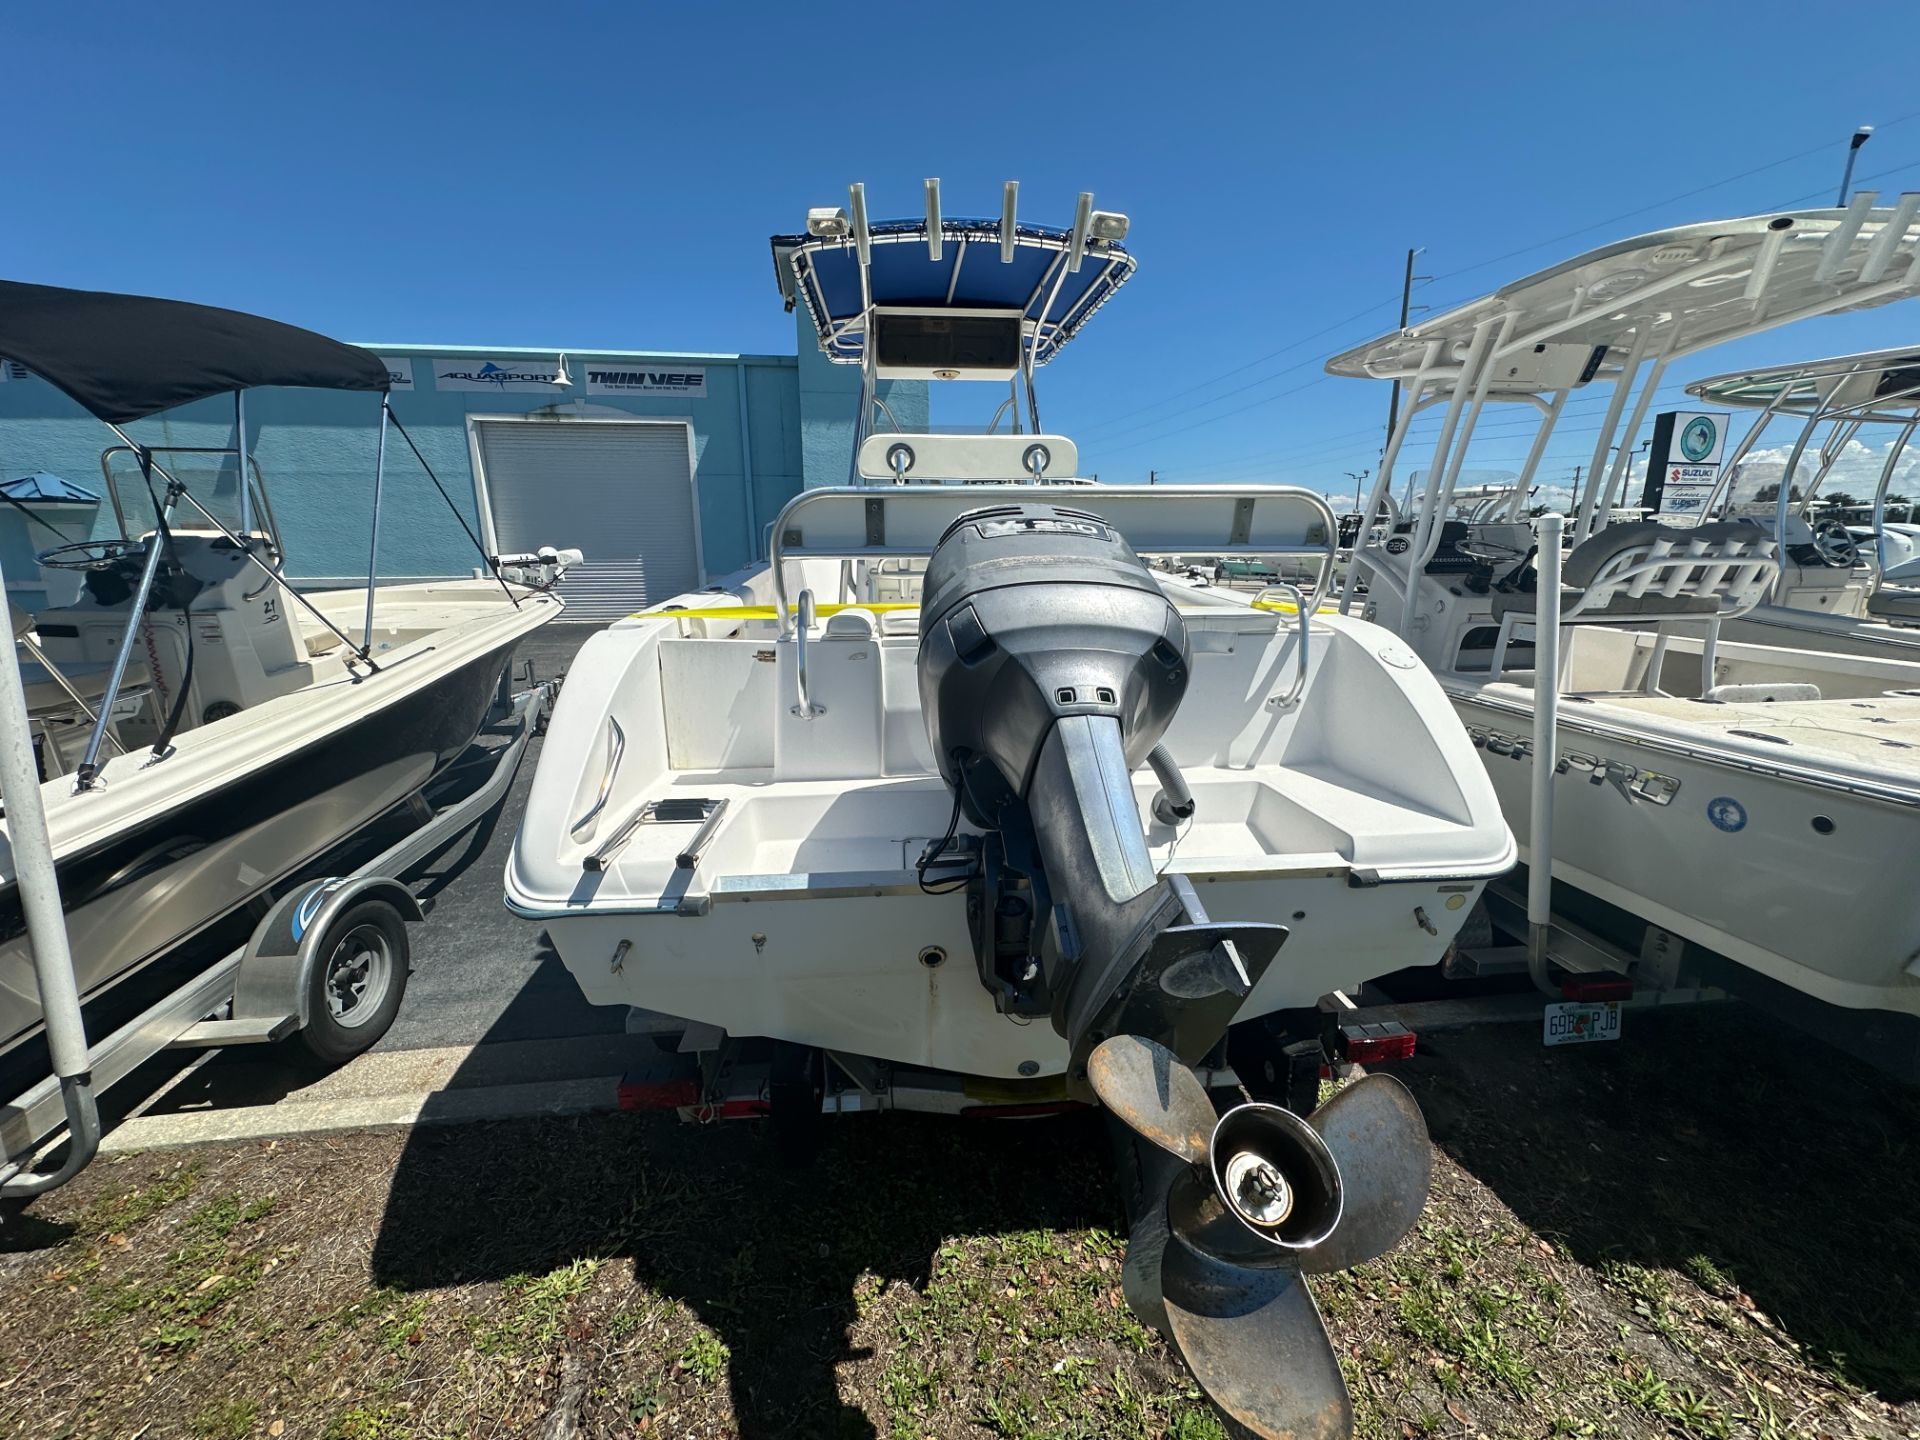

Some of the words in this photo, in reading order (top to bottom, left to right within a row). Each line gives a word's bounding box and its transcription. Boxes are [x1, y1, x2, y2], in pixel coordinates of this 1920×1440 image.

[438, 372, 558, 381] AQUASPORT
[588, 371, 646, 384] TWIN
[648, 373, 704, 386] VEE
[1682, 469, 1713, 477] SUZUKI
[1389, 541, 1408, 552] 228
[263, 599, 276, 615] 21
